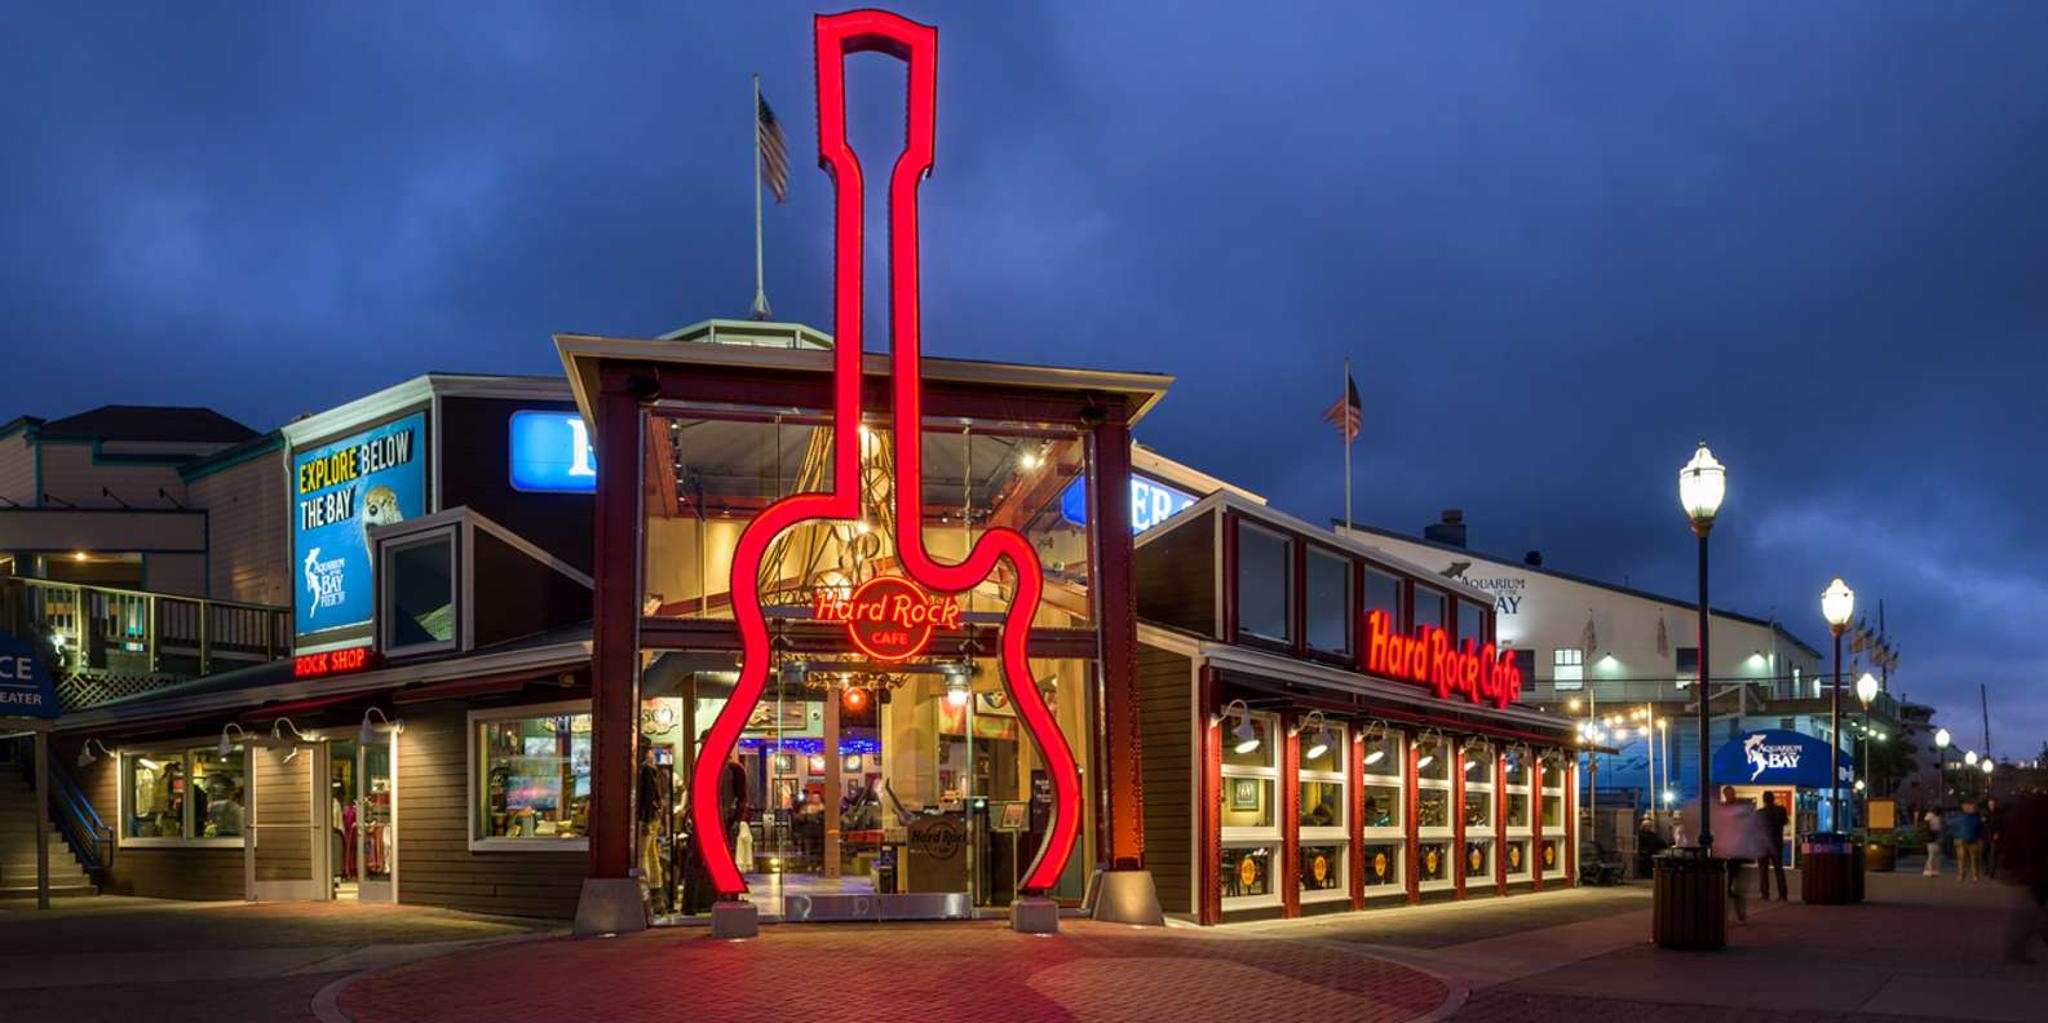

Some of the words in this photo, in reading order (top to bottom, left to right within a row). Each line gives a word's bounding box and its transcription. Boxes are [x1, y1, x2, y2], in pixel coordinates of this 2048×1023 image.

[299, 447, 358, 494] EXPLORE
[361, 430, 411, 477] BELOW
[300, 496, 325, 530] THE
[326, 488, 353, 524] BAY
[321, 574, 344, 595] BAY
[1461, 575, 1526, 589] AQUARIUM
[817, 593, 888, 621] Hard
[893, 594, 960, 629] Rock
[1495, 596, 1522, 614] AY
[871, 632, 910, 646] CAFE
[295, 652, 329, 677] ROCK
[331, 648, 366, 671] SHOP
[1368, 609, 1431, 682] Hard
[1431, 627, 1480, 704] Rock
[1480, 642, 1522, 712] Cafe
[1768, 754, 1801, 768] BAY
